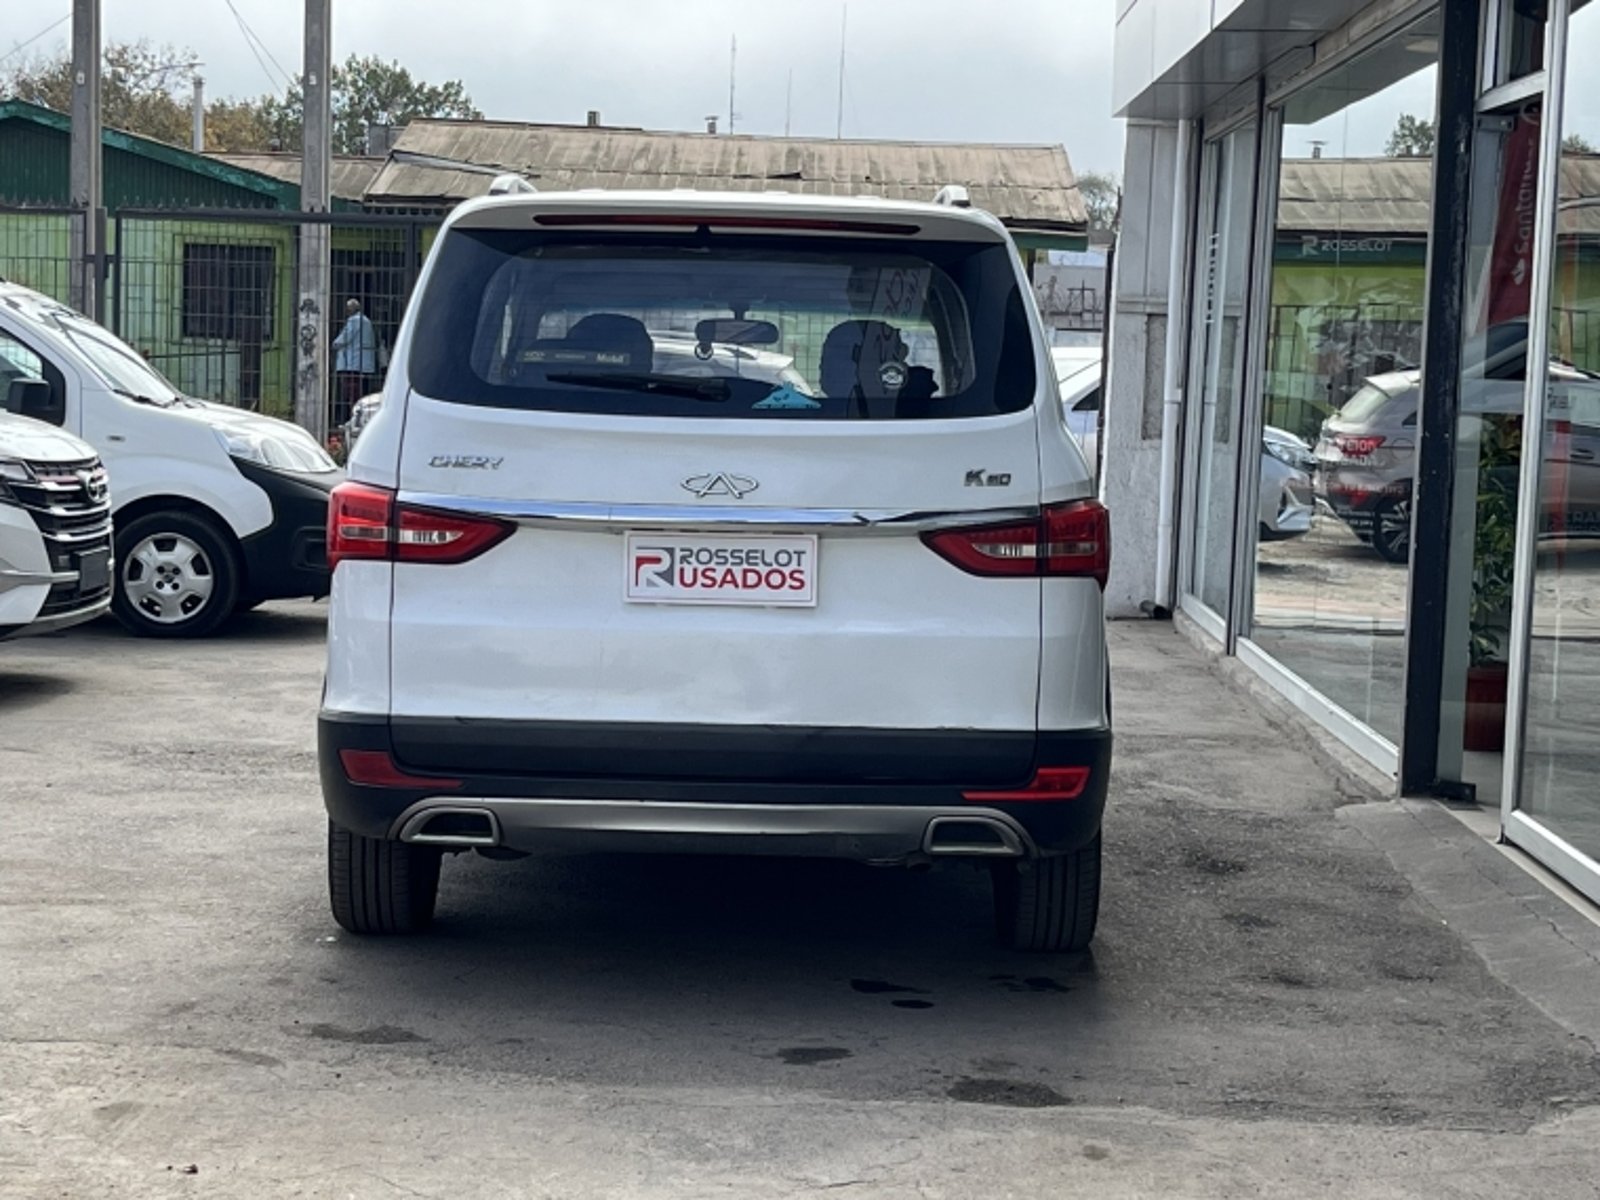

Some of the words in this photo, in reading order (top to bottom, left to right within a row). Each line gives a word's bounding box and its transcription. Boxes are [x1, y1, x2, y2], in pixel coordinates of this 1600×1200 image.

[1321, 240, 1392, 251] ROSSELOT
[428, 455, 504, 470] CHERY
[679, 547, 807, 567] ROSSELOT
[679, 567, 806, 590] USADOS
